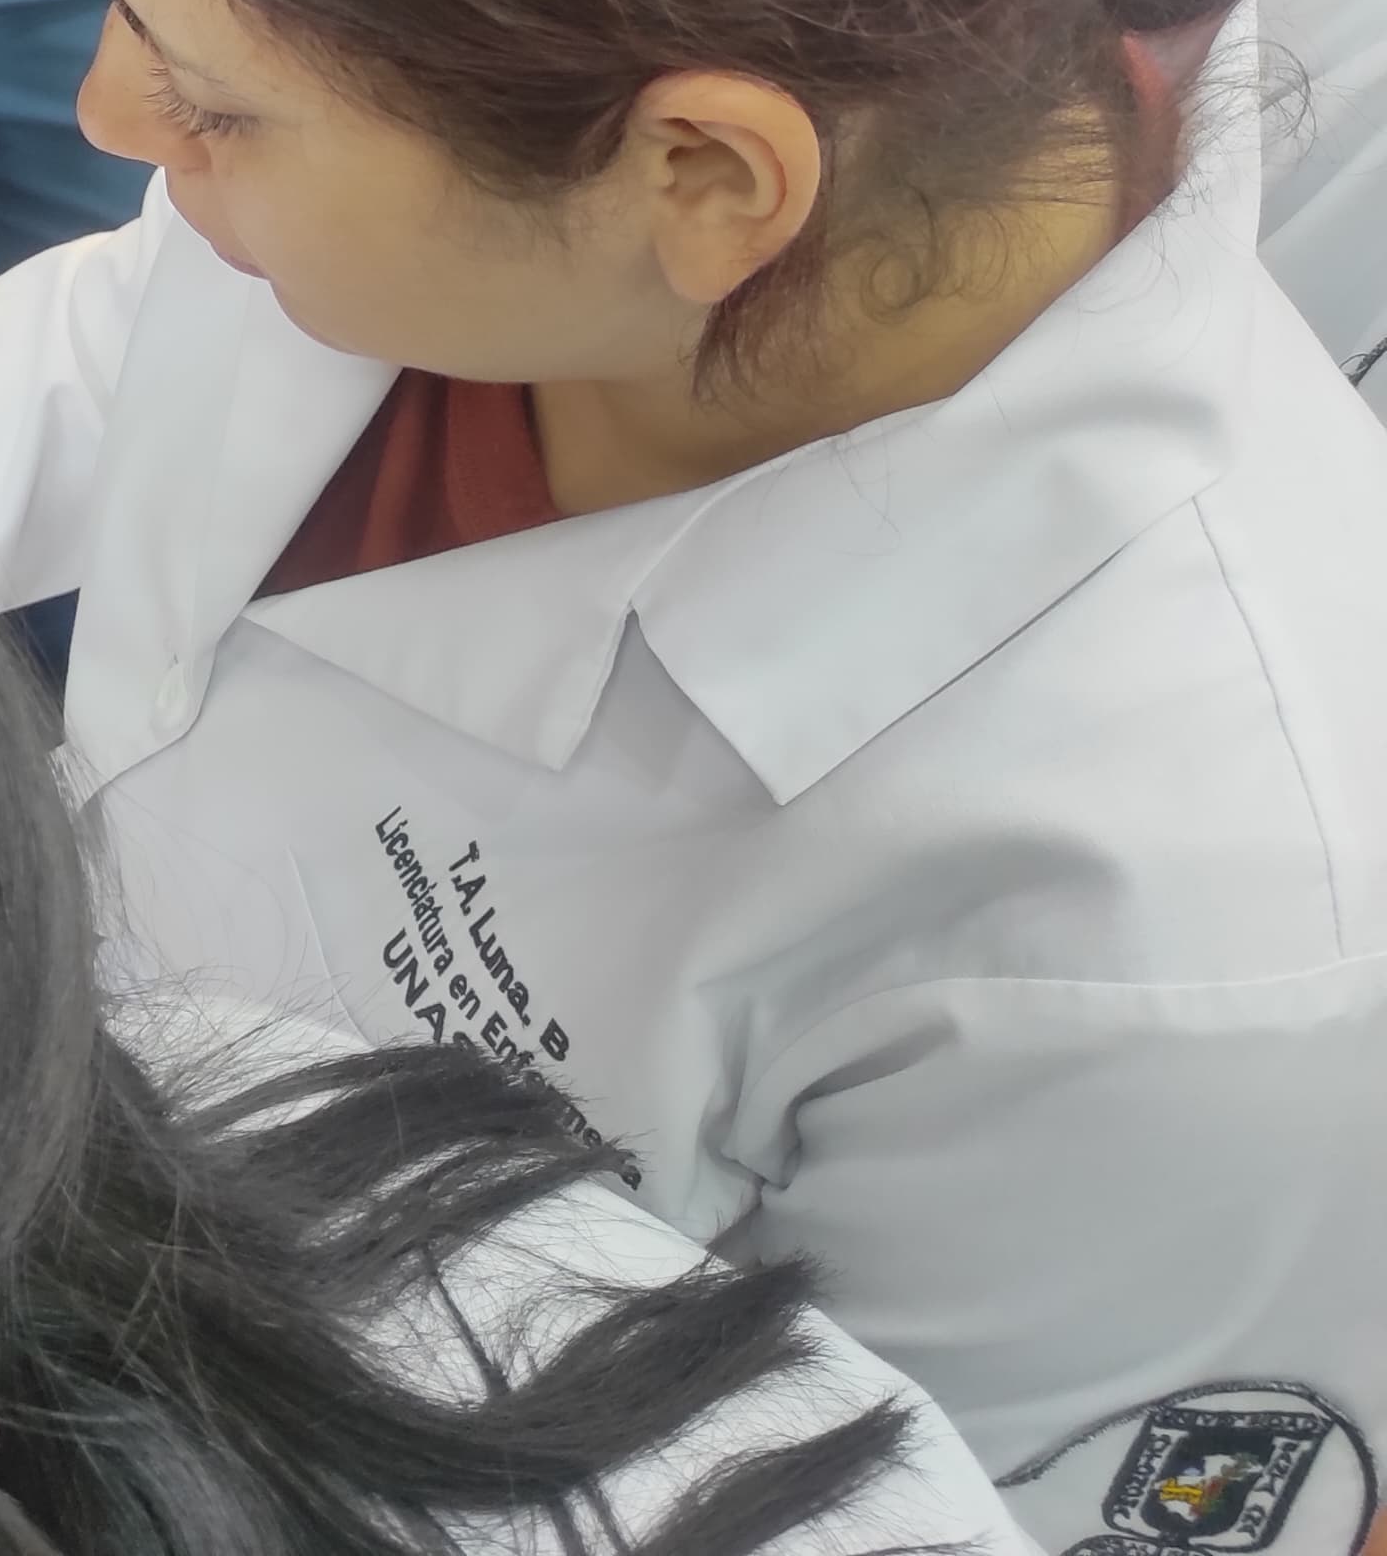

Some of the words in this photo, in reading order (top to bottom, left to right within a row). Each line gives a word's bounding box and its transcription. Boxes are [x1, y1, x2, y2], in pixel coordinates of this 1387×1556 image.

[375, 806, 454, 976] Licenciatura
[449, 974, 482, 1020] en
[539, 1018, 570, 1062] B
